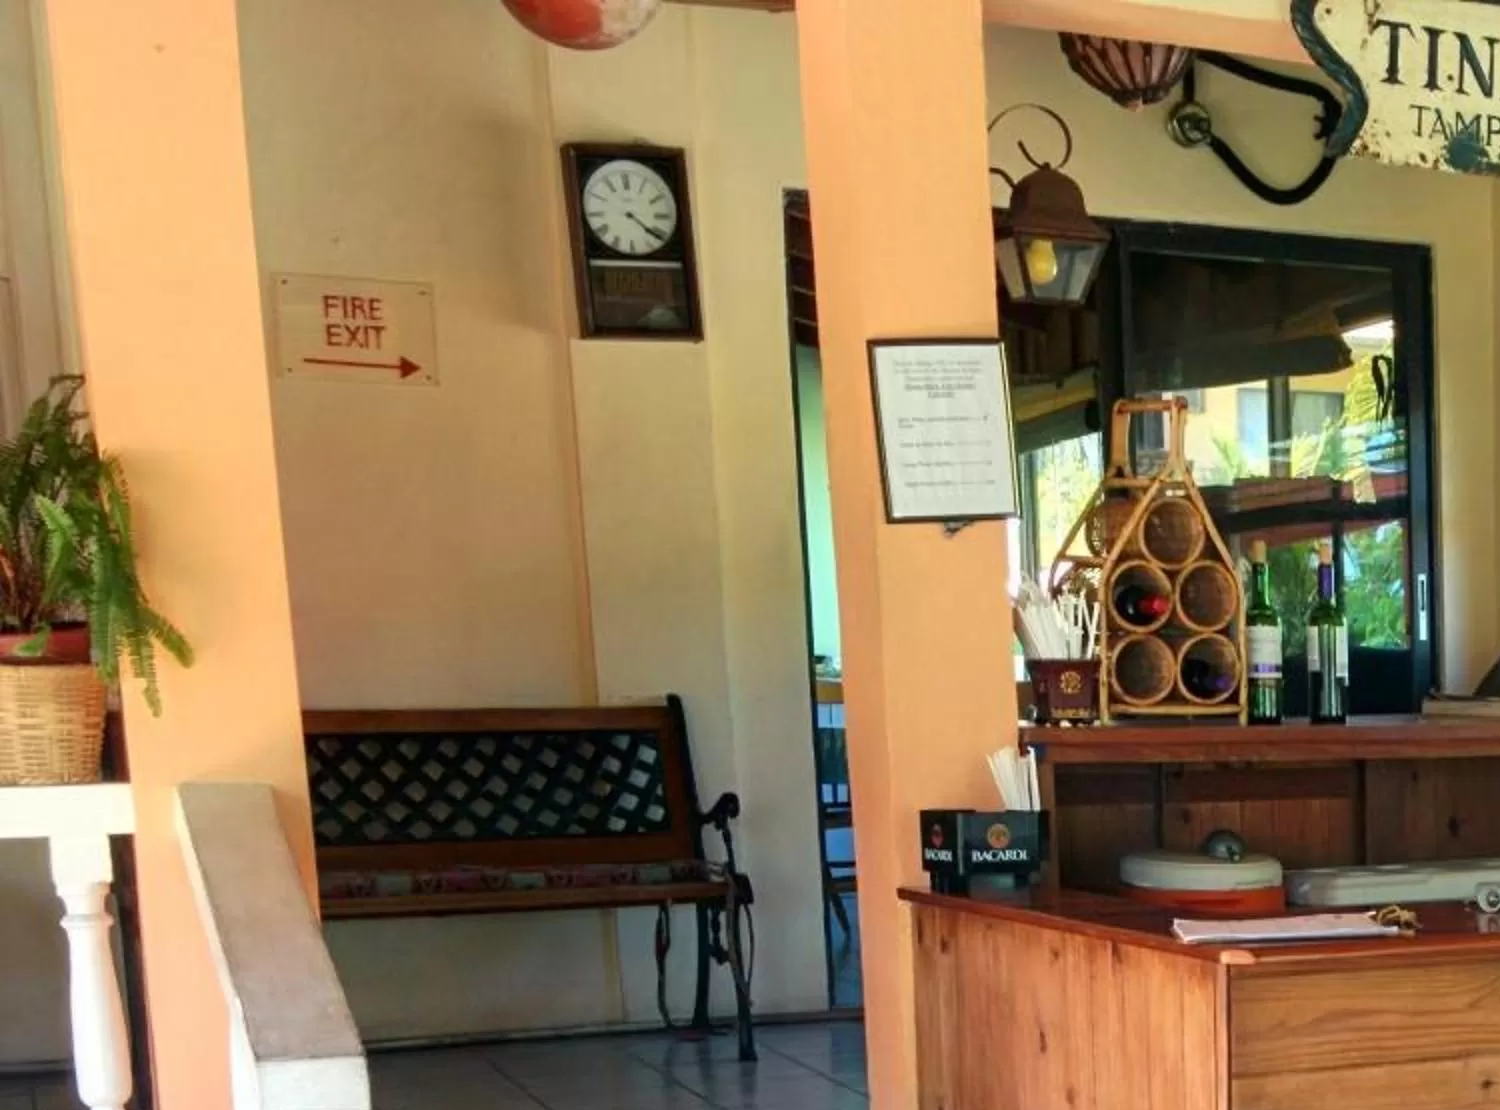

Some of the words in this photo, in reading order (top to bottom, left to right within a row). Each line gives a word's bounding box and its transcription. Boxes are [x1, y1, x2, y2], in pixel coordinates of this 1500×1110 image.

[322, 295, 384, 321] FIRE
[325, 323, 387, 350] EXIT
[972, 849, 1027, 862] BACARDI
